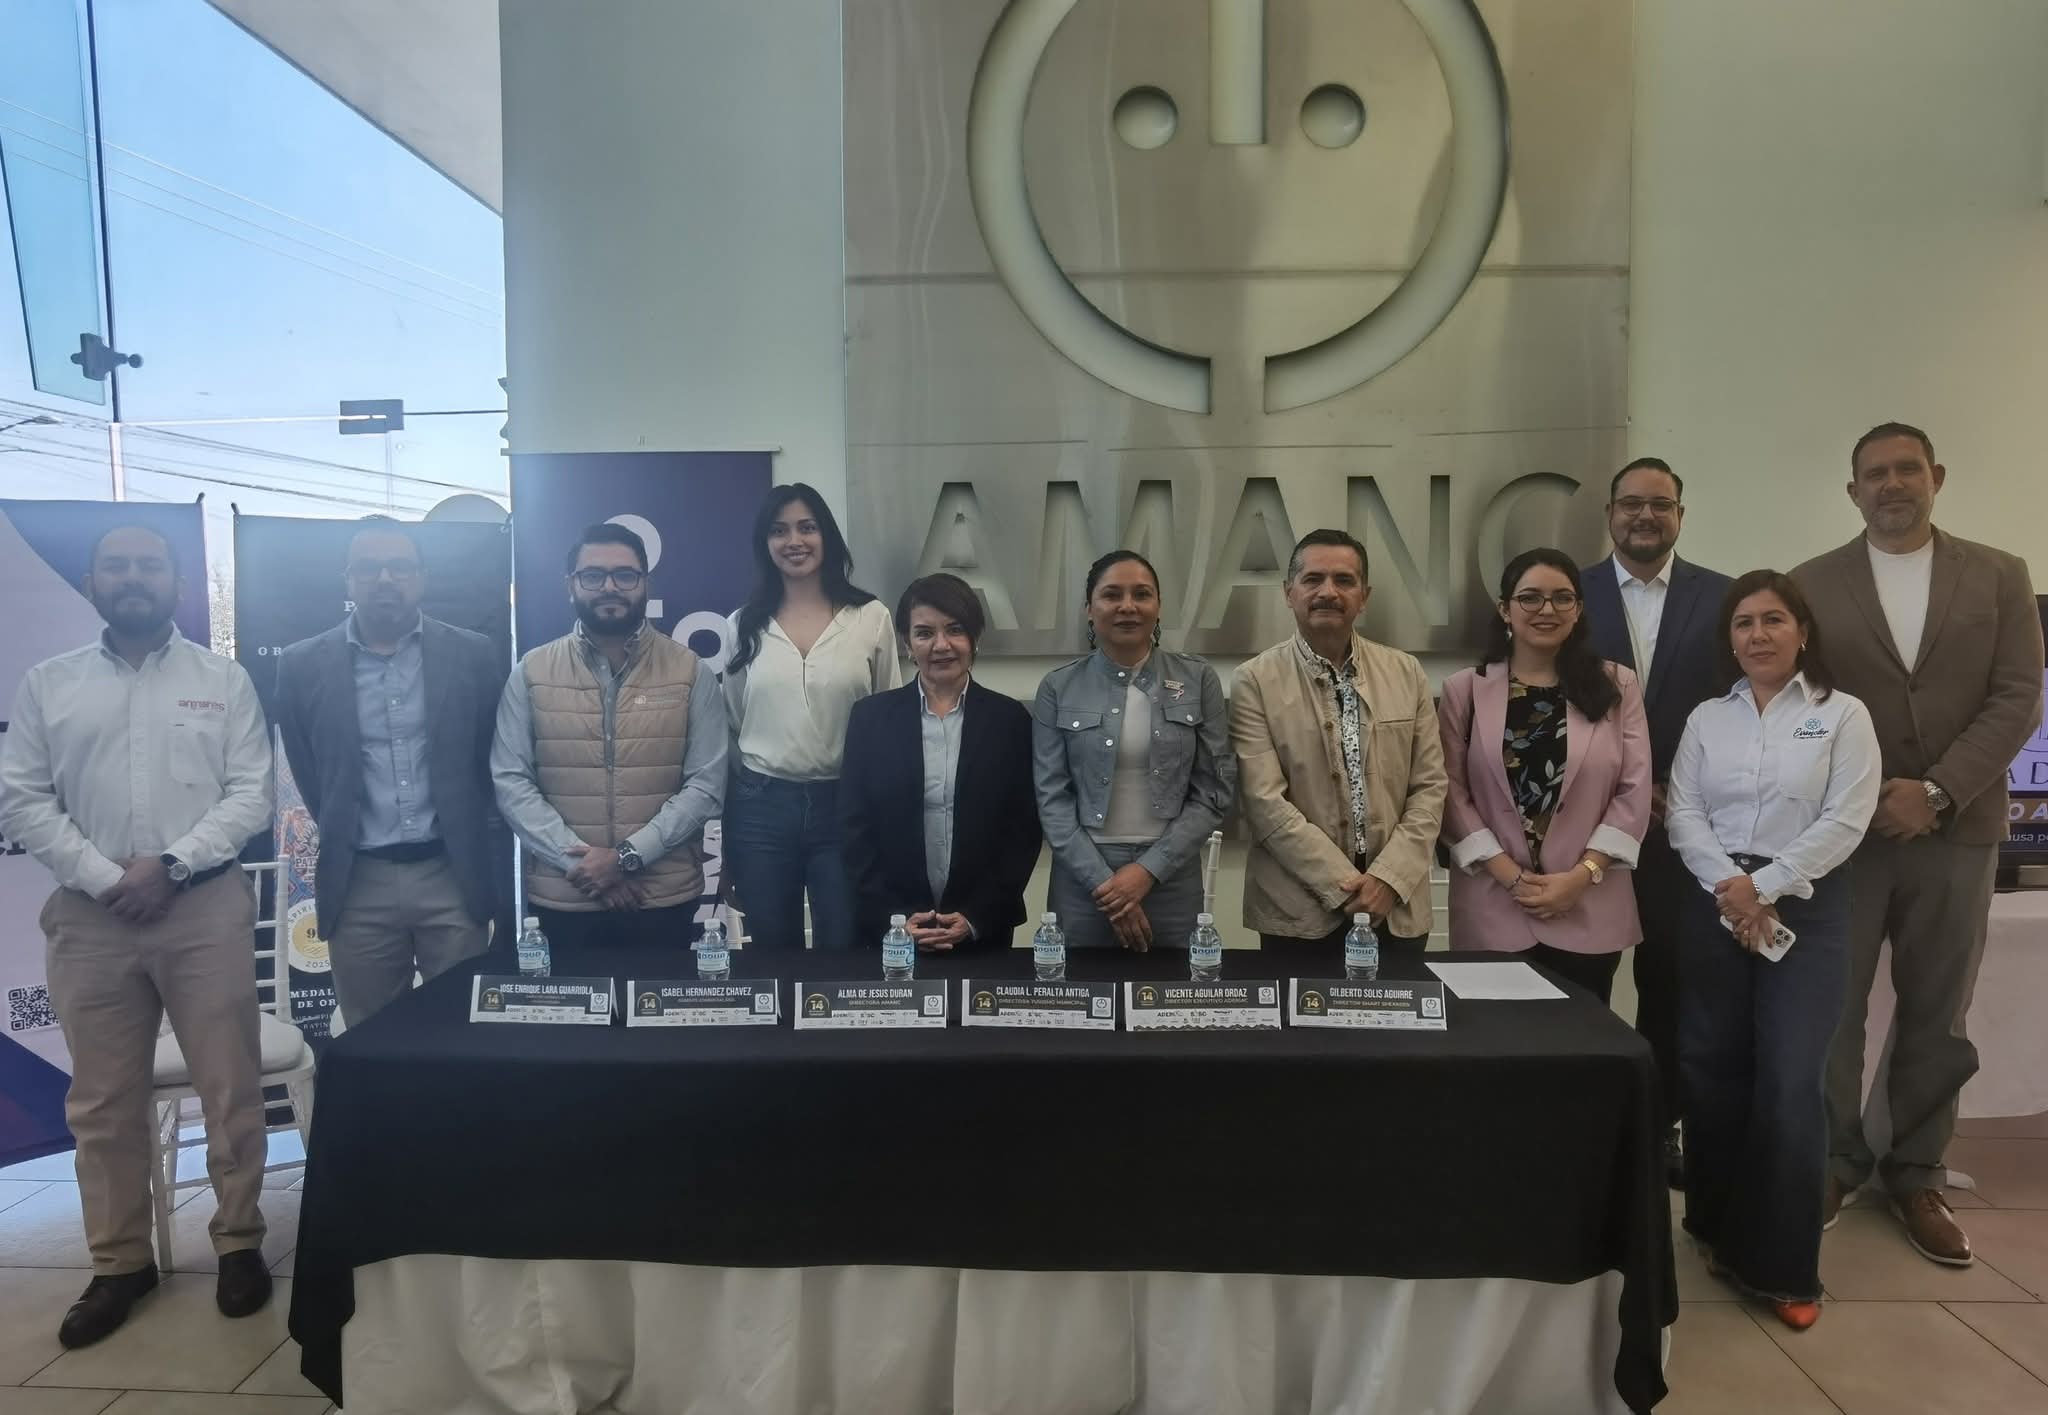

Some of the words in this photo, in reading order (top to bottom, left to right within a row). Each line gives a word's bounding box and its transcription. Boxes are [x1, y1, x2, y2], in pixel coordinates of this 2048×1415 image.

[515, 984, 541, 994] ENRIQUE
[542, 985, 558, 994] LARA
[661, 986, 684, 997] ISABEL
[686, 986, 725, 996] HERNANDEZ
[726, 986, 752, 996] CHAVEZ
[838, 989, 857, 999] ALMA
[858, 989, 867, 998] DE
[868, 989, 888, 998] JESUS
[889, 988, 913, 998] DURAN
[996, 986, 1025, 996] CLAUDIA
[1034, 987, 1064, 997] PERALTA
[1065, 988, 1090, 998] ANTIGA
[1165, 989, 1193, 999] VICENTE
[1194, 989, 1223, 998] AGUILAR
[1225, 988, 1248, 998] ORDAZ
[1329, 987, 1362, 998] GILBERTO
[1363, 988, 1383, 998] SOLIS
[1384, 989, 1413, 999] AGUIRRE
[297, 1000, 314, 1008] DE
